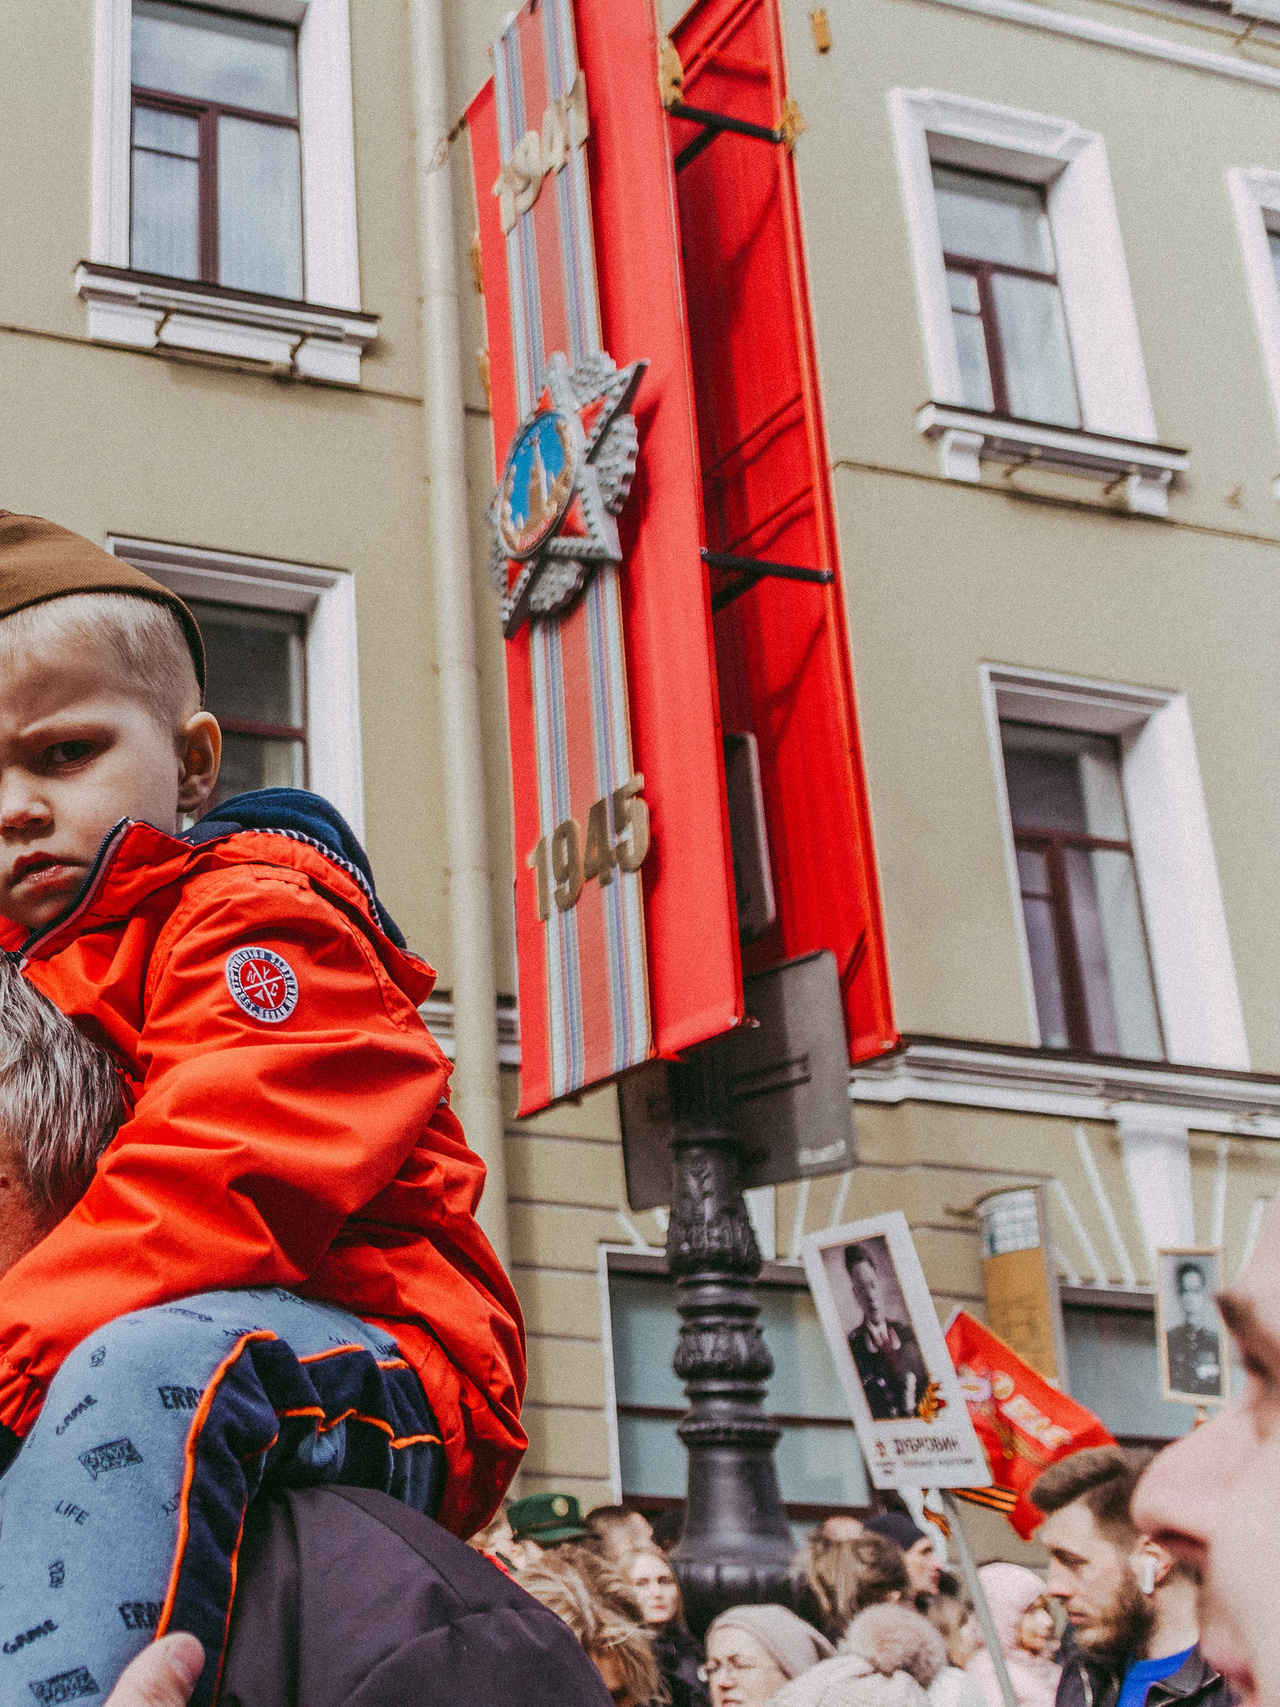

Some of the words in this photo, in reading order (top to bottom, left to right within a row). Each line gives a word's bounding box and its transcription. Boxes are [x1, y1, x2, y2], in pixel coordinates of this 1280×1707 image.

[527, 771, 651, 921] 1945
[55, 1394, 98, 1435] GAME
[158, 1385, 205, 1410] ERR
[55, 1499, 90, 1526] LIFE
[2, 1618, 59, 1655] GAME
